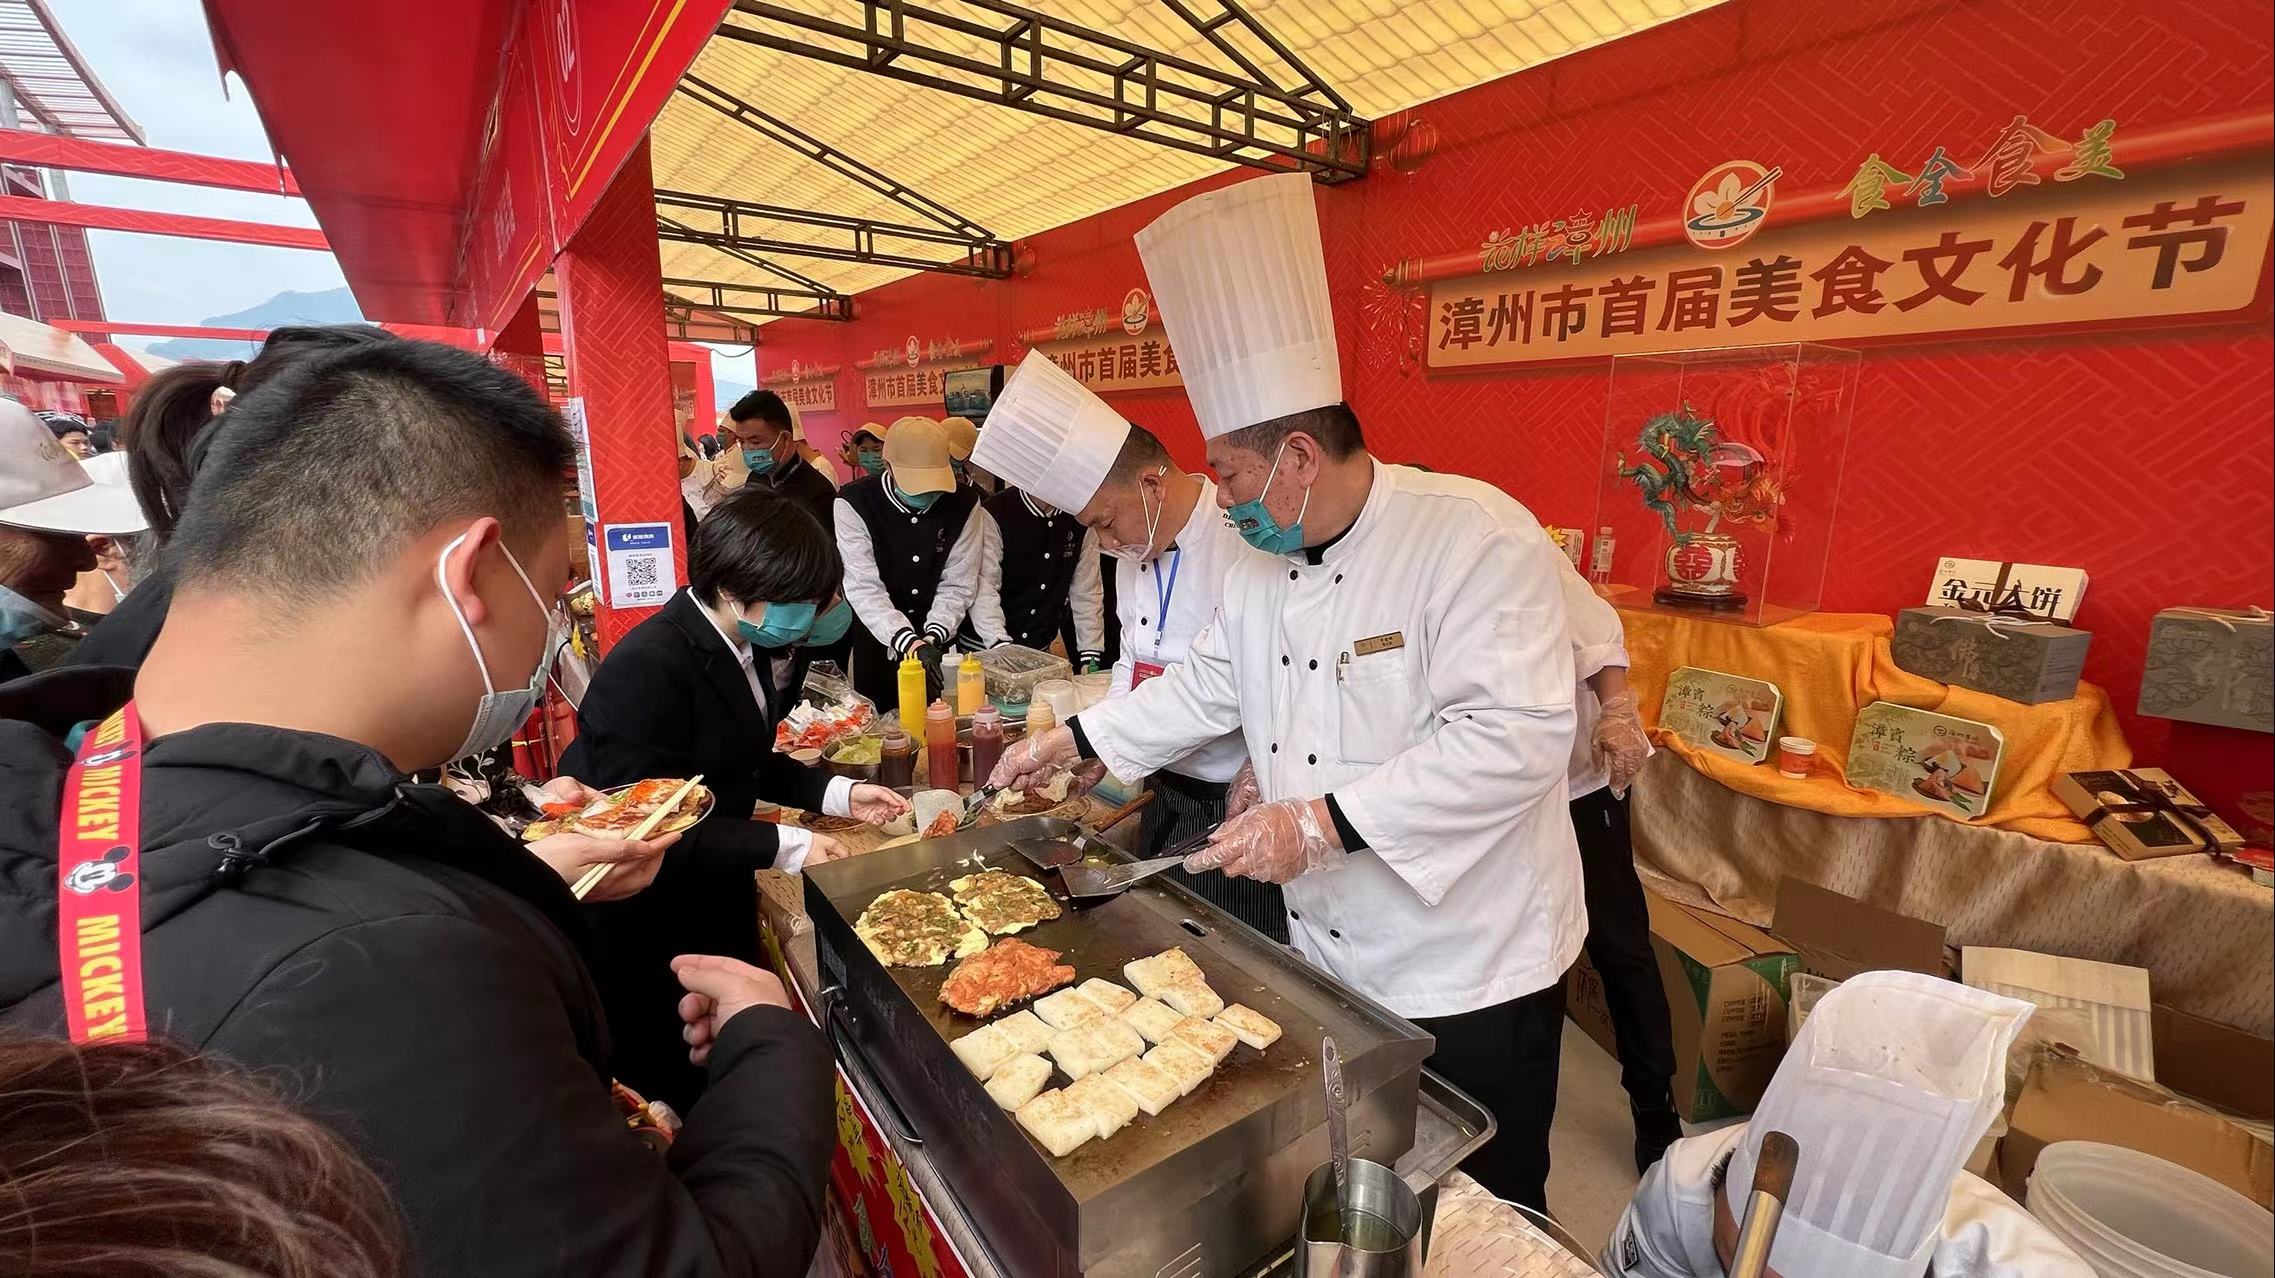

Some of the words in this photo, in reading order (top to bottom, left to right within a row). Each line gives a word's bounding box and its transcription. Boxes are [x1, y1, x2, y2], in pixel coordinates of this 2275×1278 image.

[1835, 115, 2126, 219] 食全食美
[1437, 194, 2247, 352] 漳州市首届美食文化节
[1480, 203, 1638, 273] 花样漳州
[77, 765, 121, 841] MICKEY
[76, 914, 129, 1038] MICKEY
